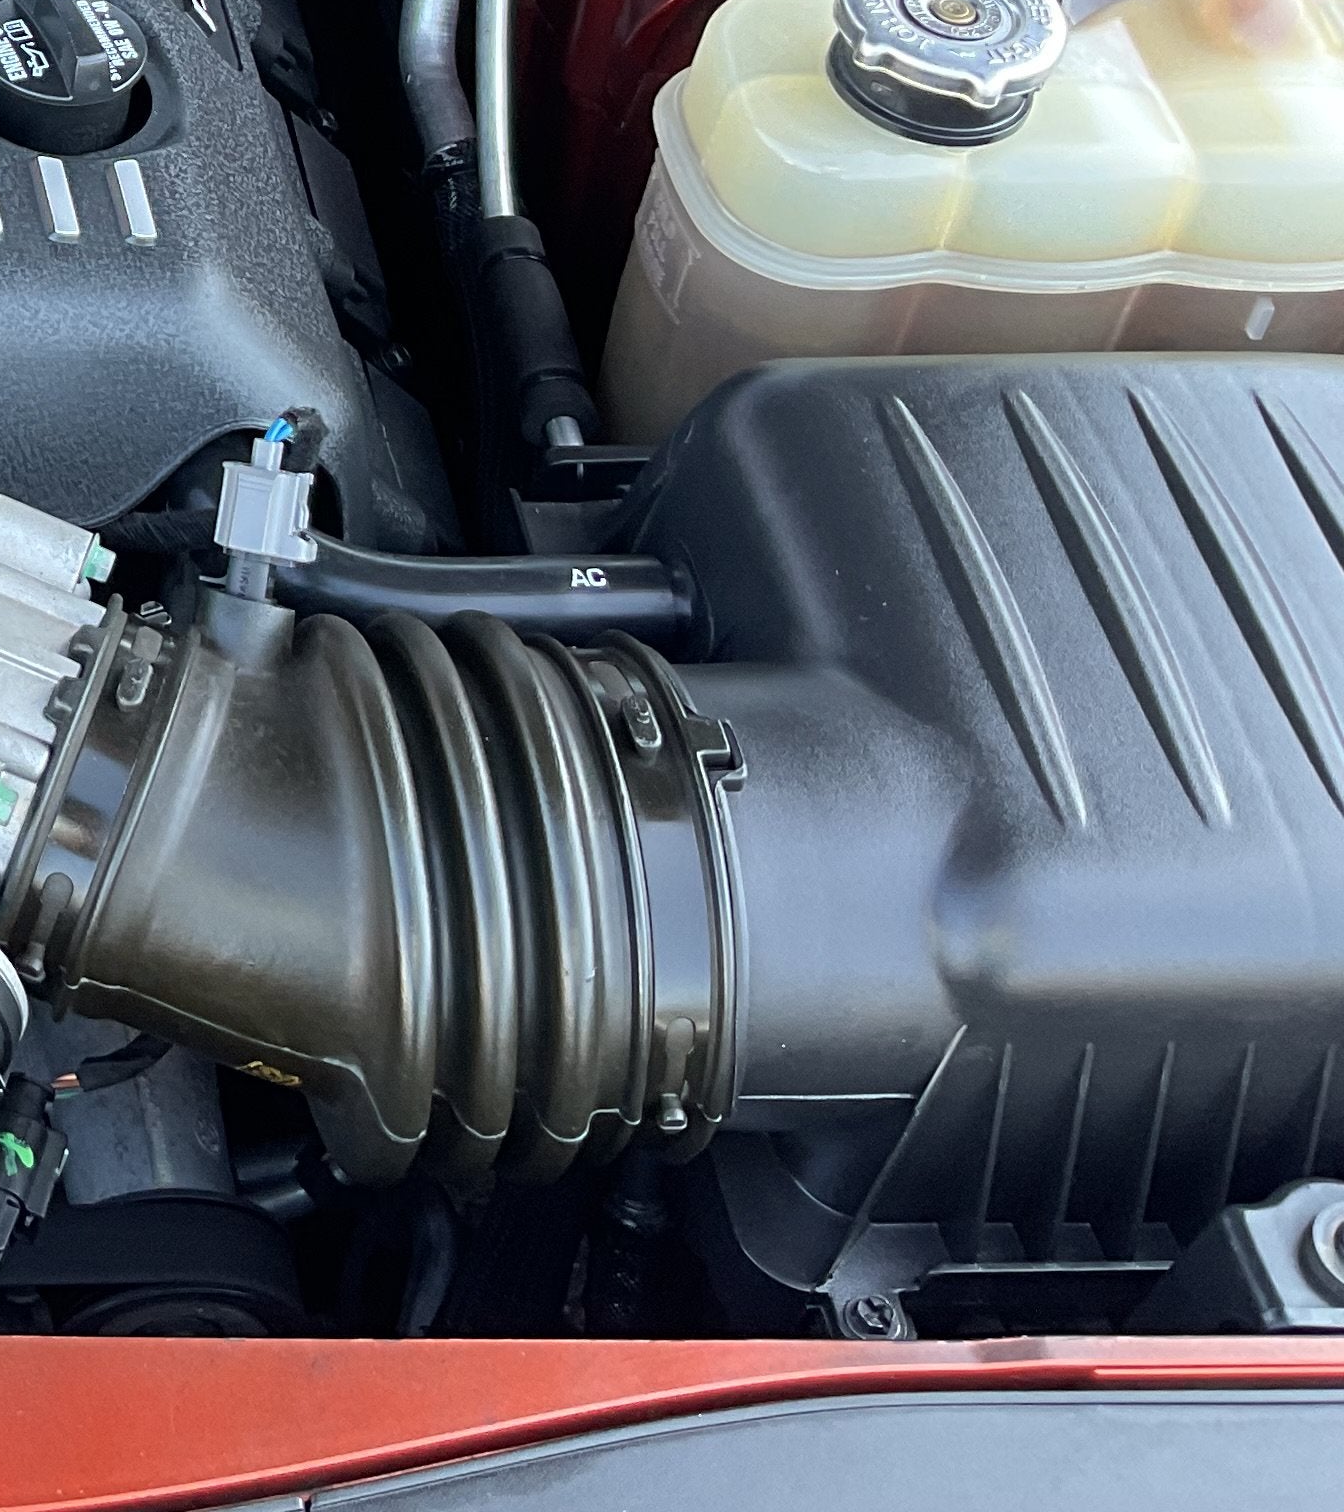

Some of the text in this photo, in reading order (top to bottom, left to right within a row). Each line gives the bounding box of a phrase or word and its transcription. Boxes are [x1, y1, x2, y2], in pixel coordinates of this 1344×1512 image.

[76, 0, 126, 67] RECOMMENDED
[113, 38, 139, 60] SAE
[570, 567, 607, 587] AC
